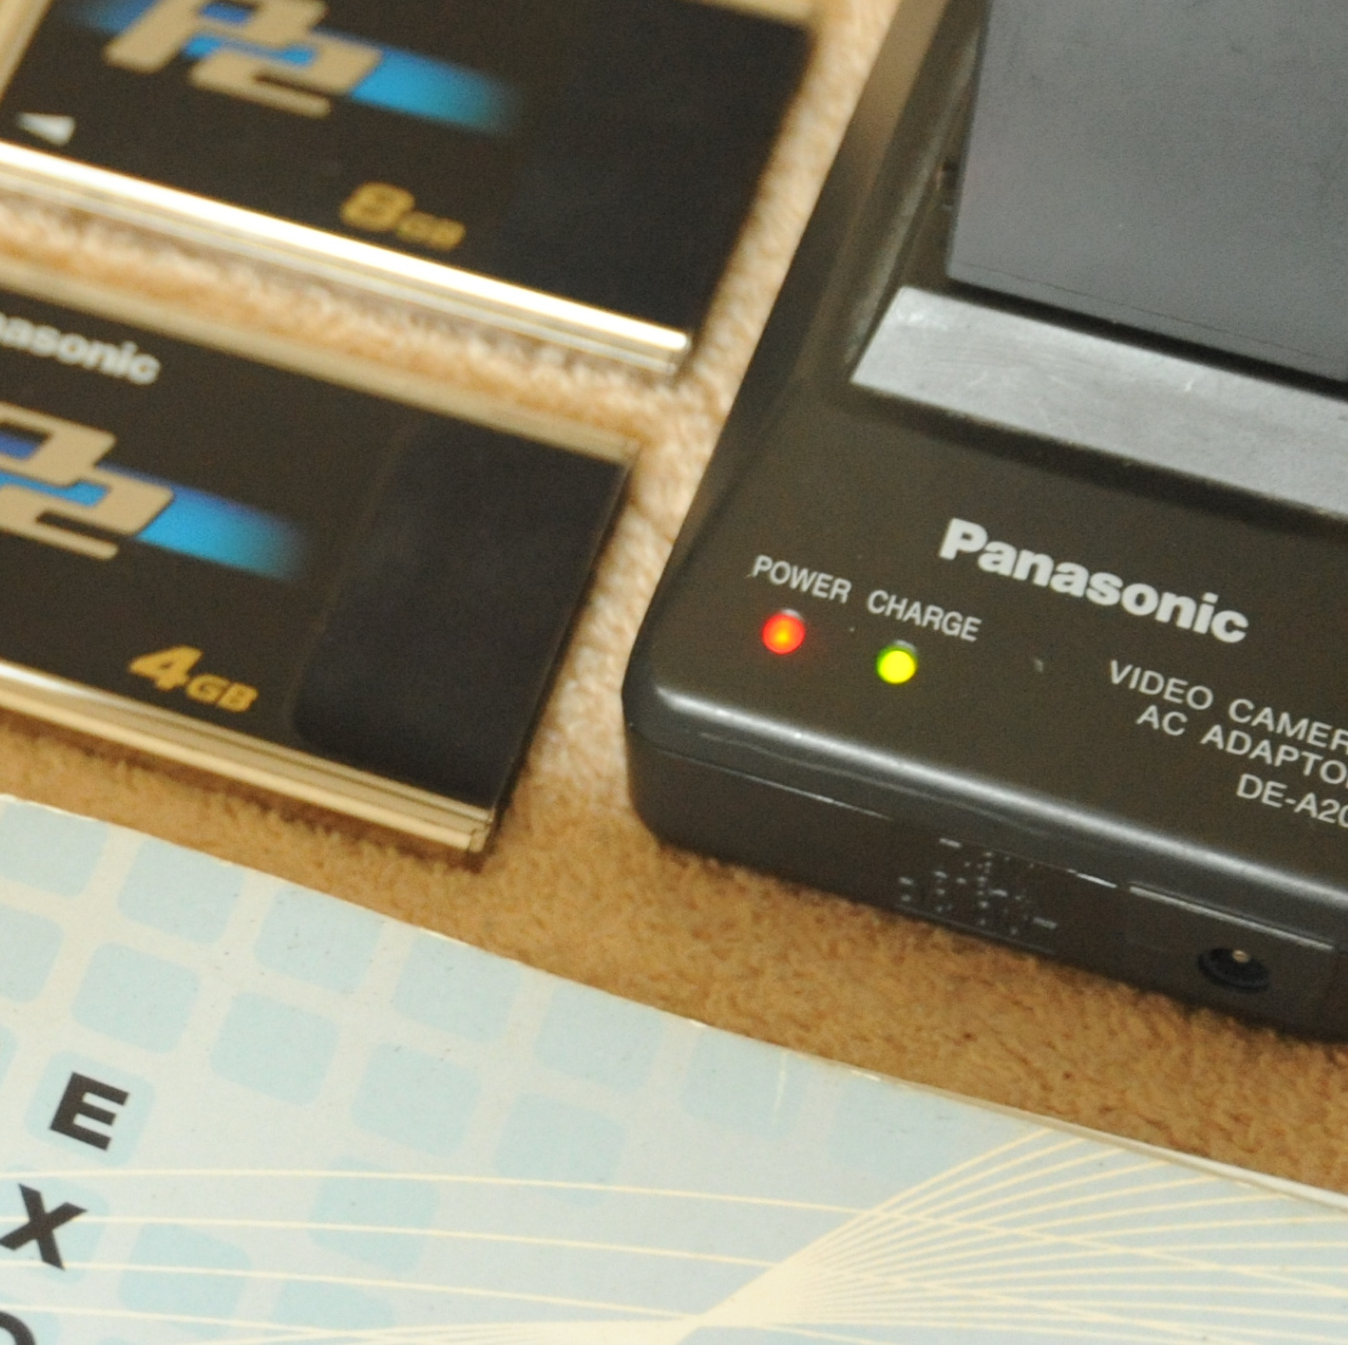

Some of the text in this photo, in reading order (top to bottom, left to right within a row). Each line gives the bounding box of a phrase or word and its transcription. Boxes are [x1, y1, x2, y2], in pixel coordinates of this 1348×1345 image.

[751, 554, 982, 643] POWER CHARGE
[938, 516, 1250, 645] Panasonic
[1110, 659, 1214, 710] VIDEO
[1136, 705, 1348, 789] AC ADAPTO
